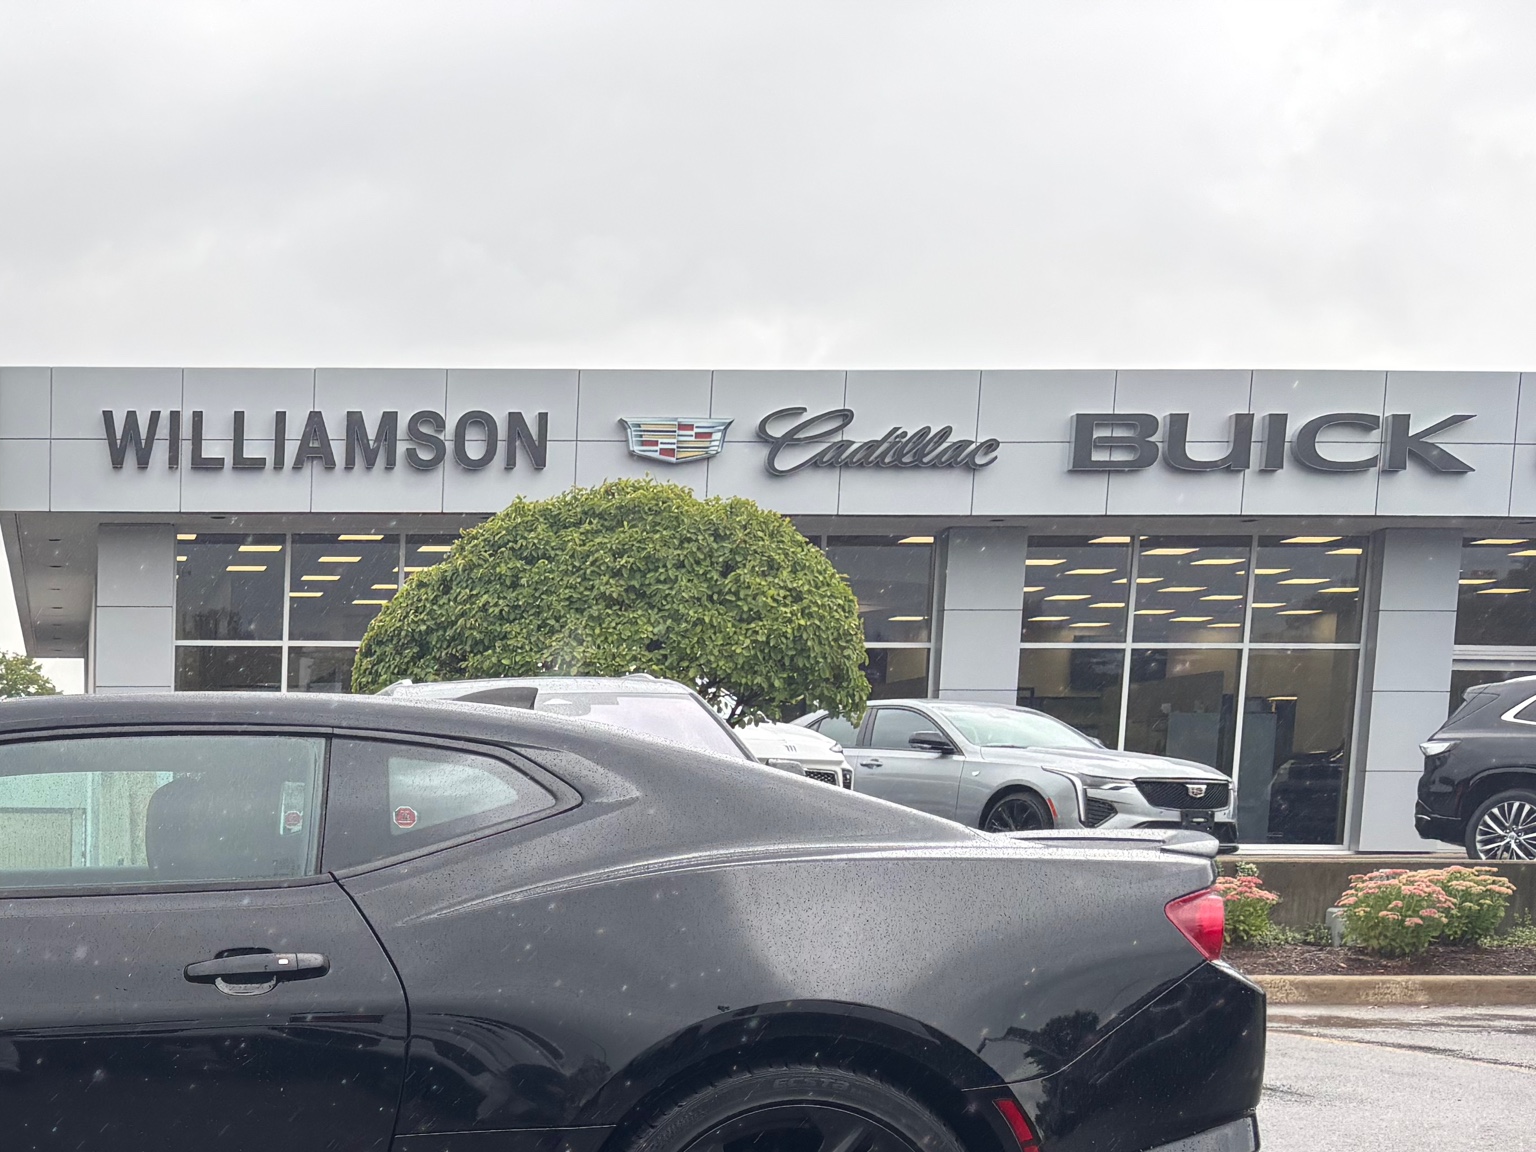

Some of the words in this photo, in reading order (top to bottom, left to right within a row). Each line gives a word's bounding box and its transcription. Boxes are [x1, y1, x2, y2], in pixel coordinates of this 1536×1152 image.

[101, 409, 550, 470] WILLIAMSON
[757, 406, 1001, 476] Cadillac
[1066, 412, 1478, 473] BUICK
